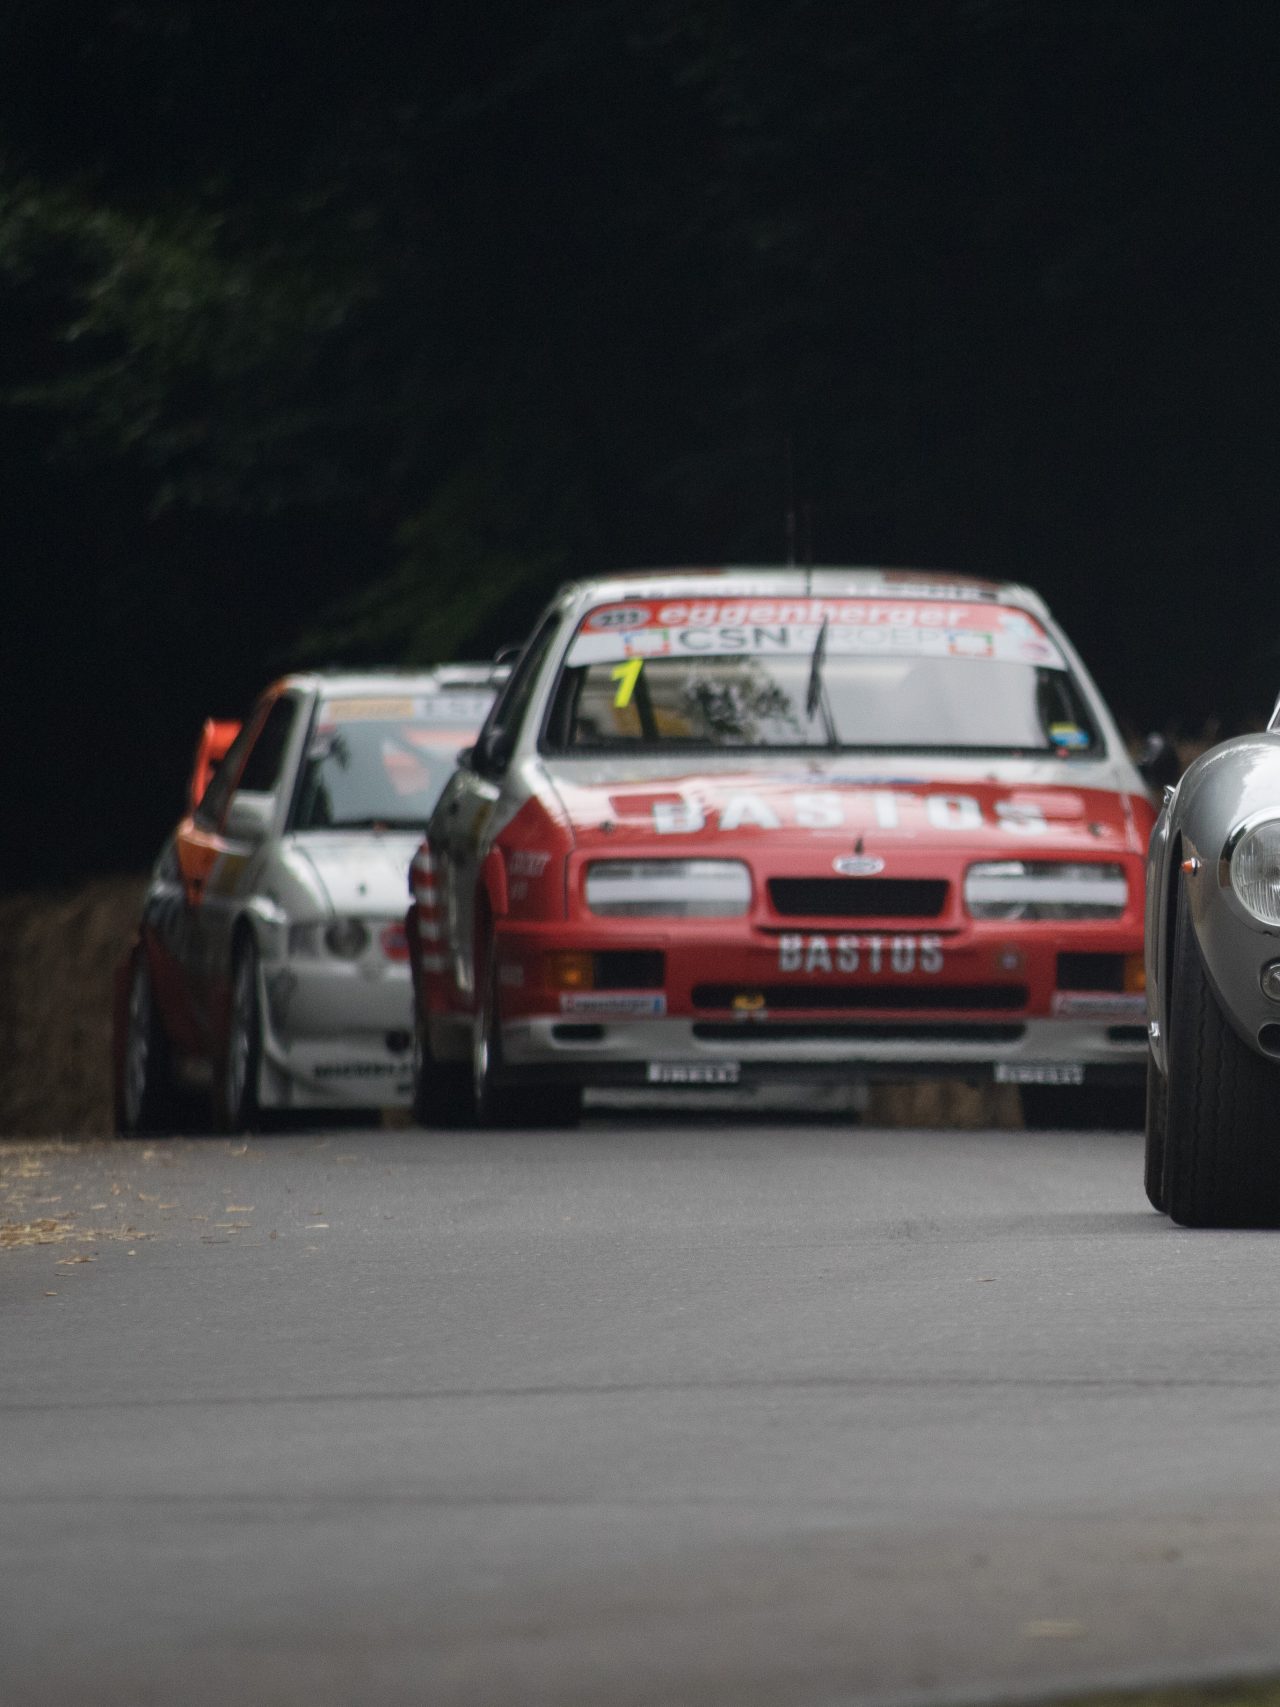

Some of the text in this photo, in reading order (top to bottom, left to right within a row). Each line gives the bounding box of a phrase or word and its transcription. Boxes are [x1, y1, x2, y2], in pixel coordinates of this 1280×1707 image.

[658, 602, 968, 626] eggenberger
[678, 628, 789, 650] CSN
[611, 656, 644, 708] 1
[653, 792, 1048, 834] BASTOS
[779, 934, 944, 973] BASTOS
